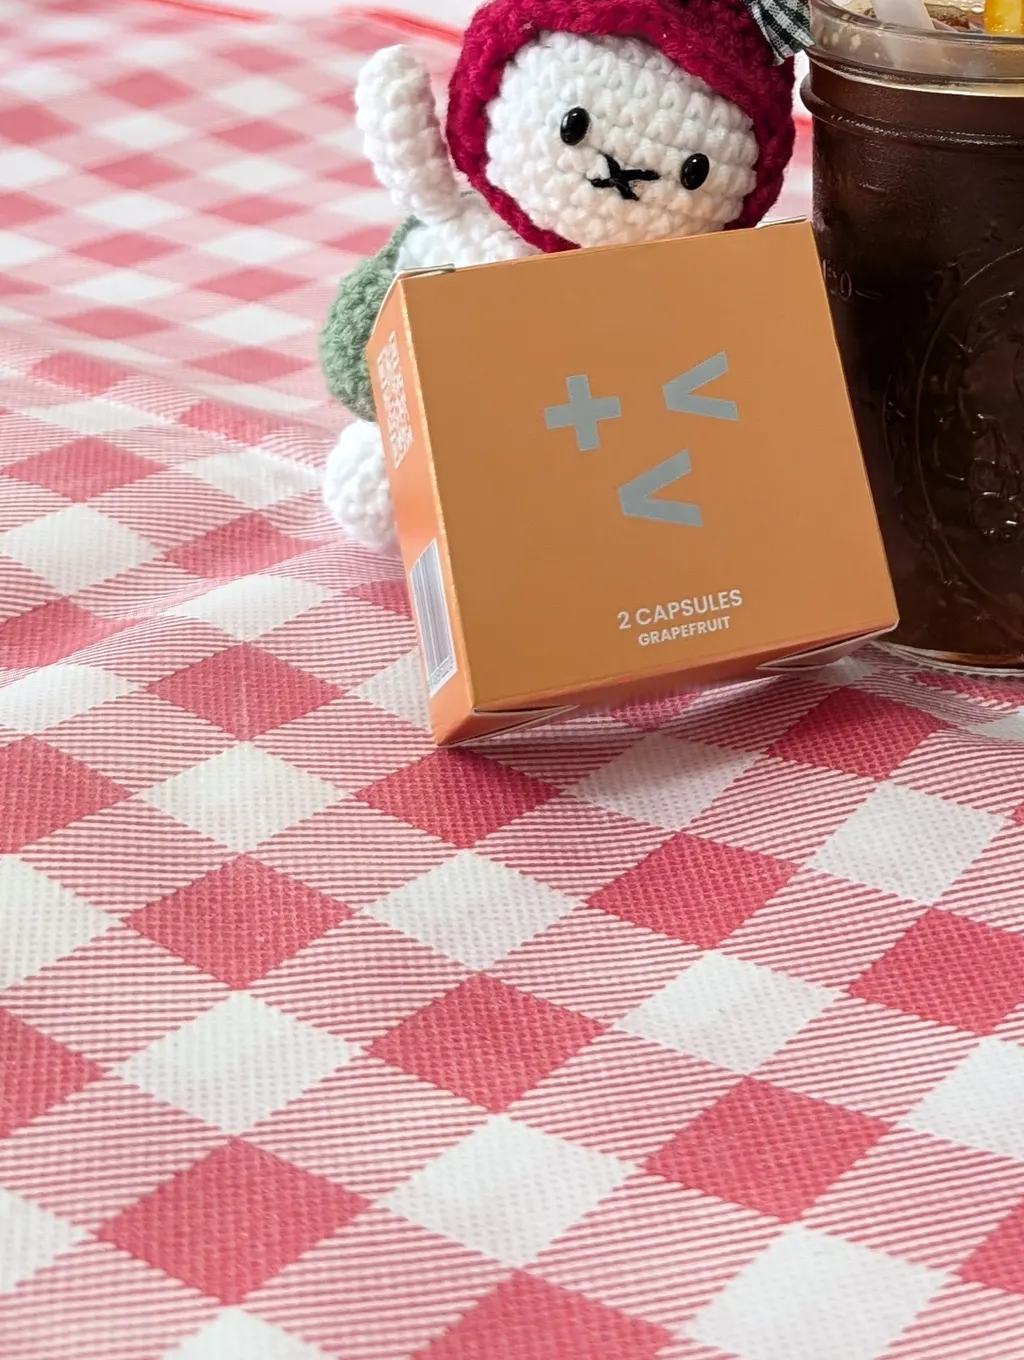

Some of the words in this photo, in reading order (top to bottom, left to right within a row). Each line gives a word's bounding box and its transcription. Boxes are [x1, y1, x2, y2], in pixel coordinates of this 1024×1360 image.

[617, 611, 632, 629] 2
[635, 589, 743, 625] CAPSULES
[638, 616, 730, 646] GRAPEFRUIT
